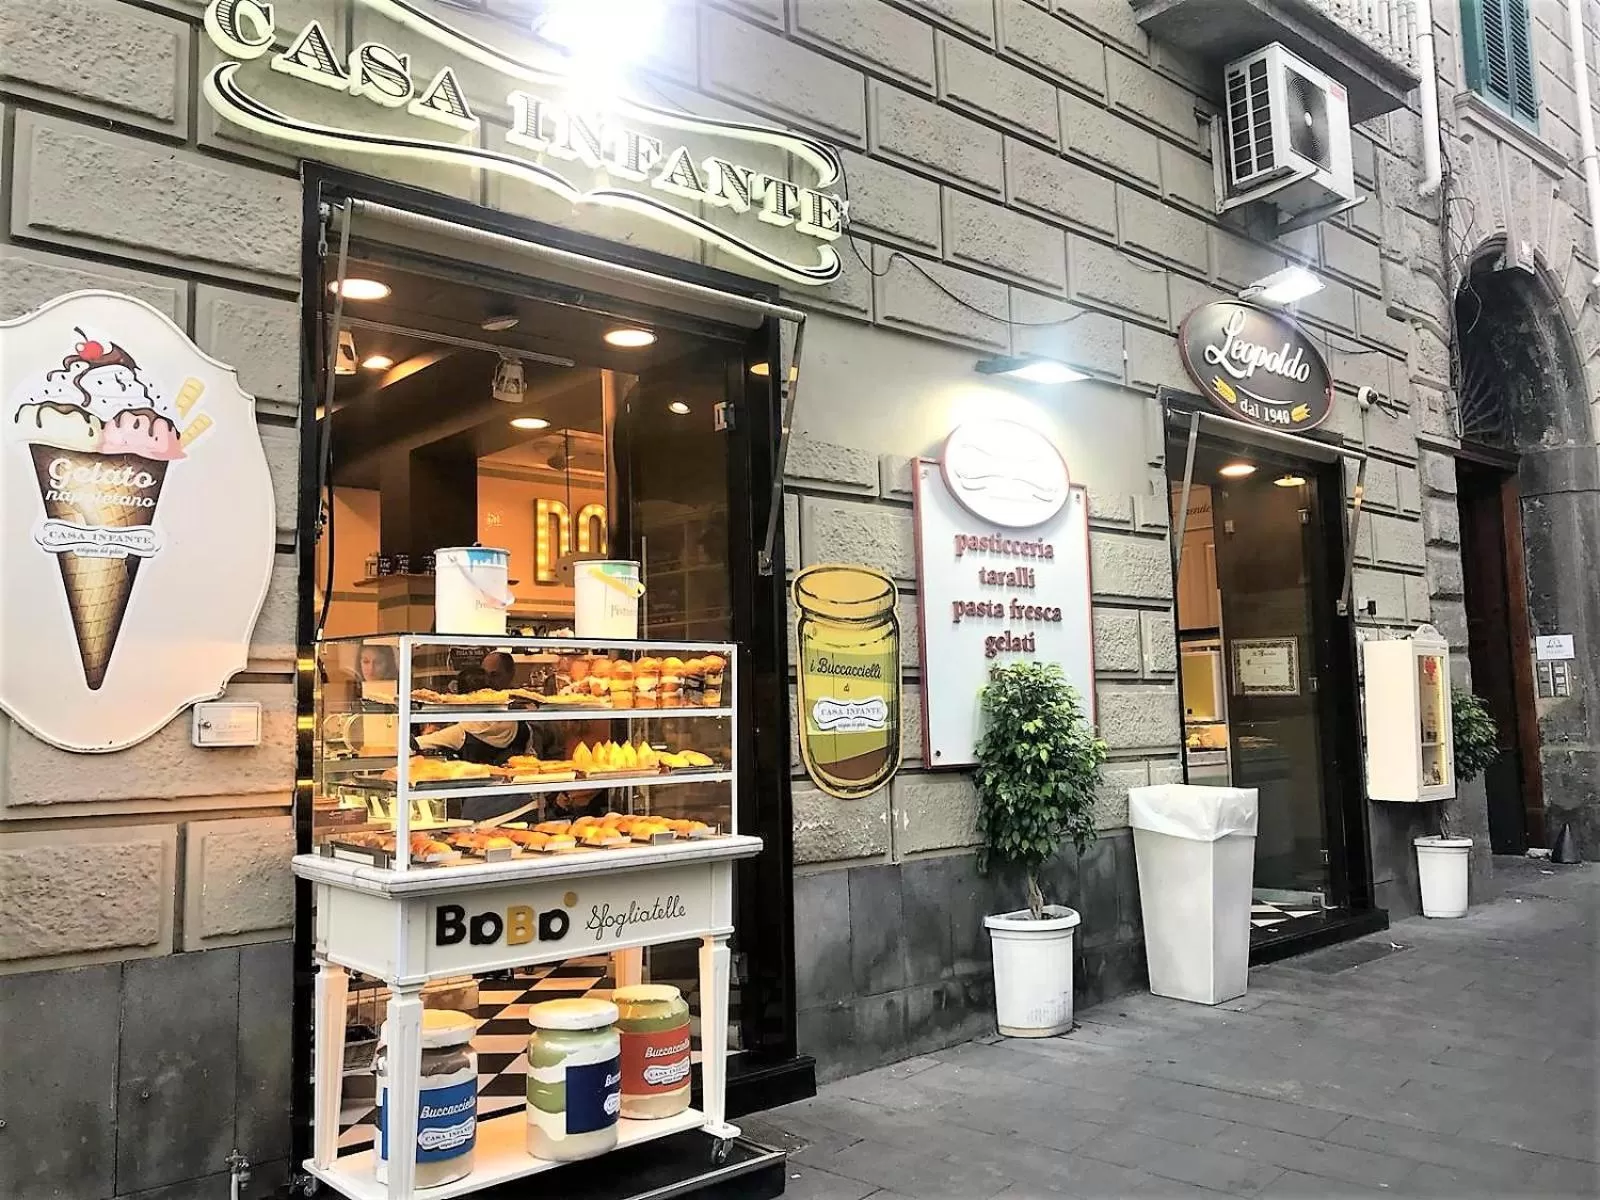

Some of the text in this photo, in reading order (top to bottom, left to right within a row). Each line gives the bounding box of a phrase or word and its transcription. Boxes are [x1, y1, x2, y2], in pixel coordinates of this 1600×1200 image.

[204, 0, 842, 241] CASA INFANTE
[1204, 309, 1311, 383] Leopoldo
[1239, 400, 1291, 424] dal 1940
[48, 458, 157, 488] Gelato
[49, 531, 151, 545] CASA INFANTE
[955, 532, 1054, 559] pasticceria
[978, 566, 1035, 589] taralli
[952, 598, 1062, 624] pasta fresca
[985, 630, 1035, 659] gelati
[821, 707, 881, 716] CASA INFANTE
[585, 894, 687, 941] Sfogliatelle
